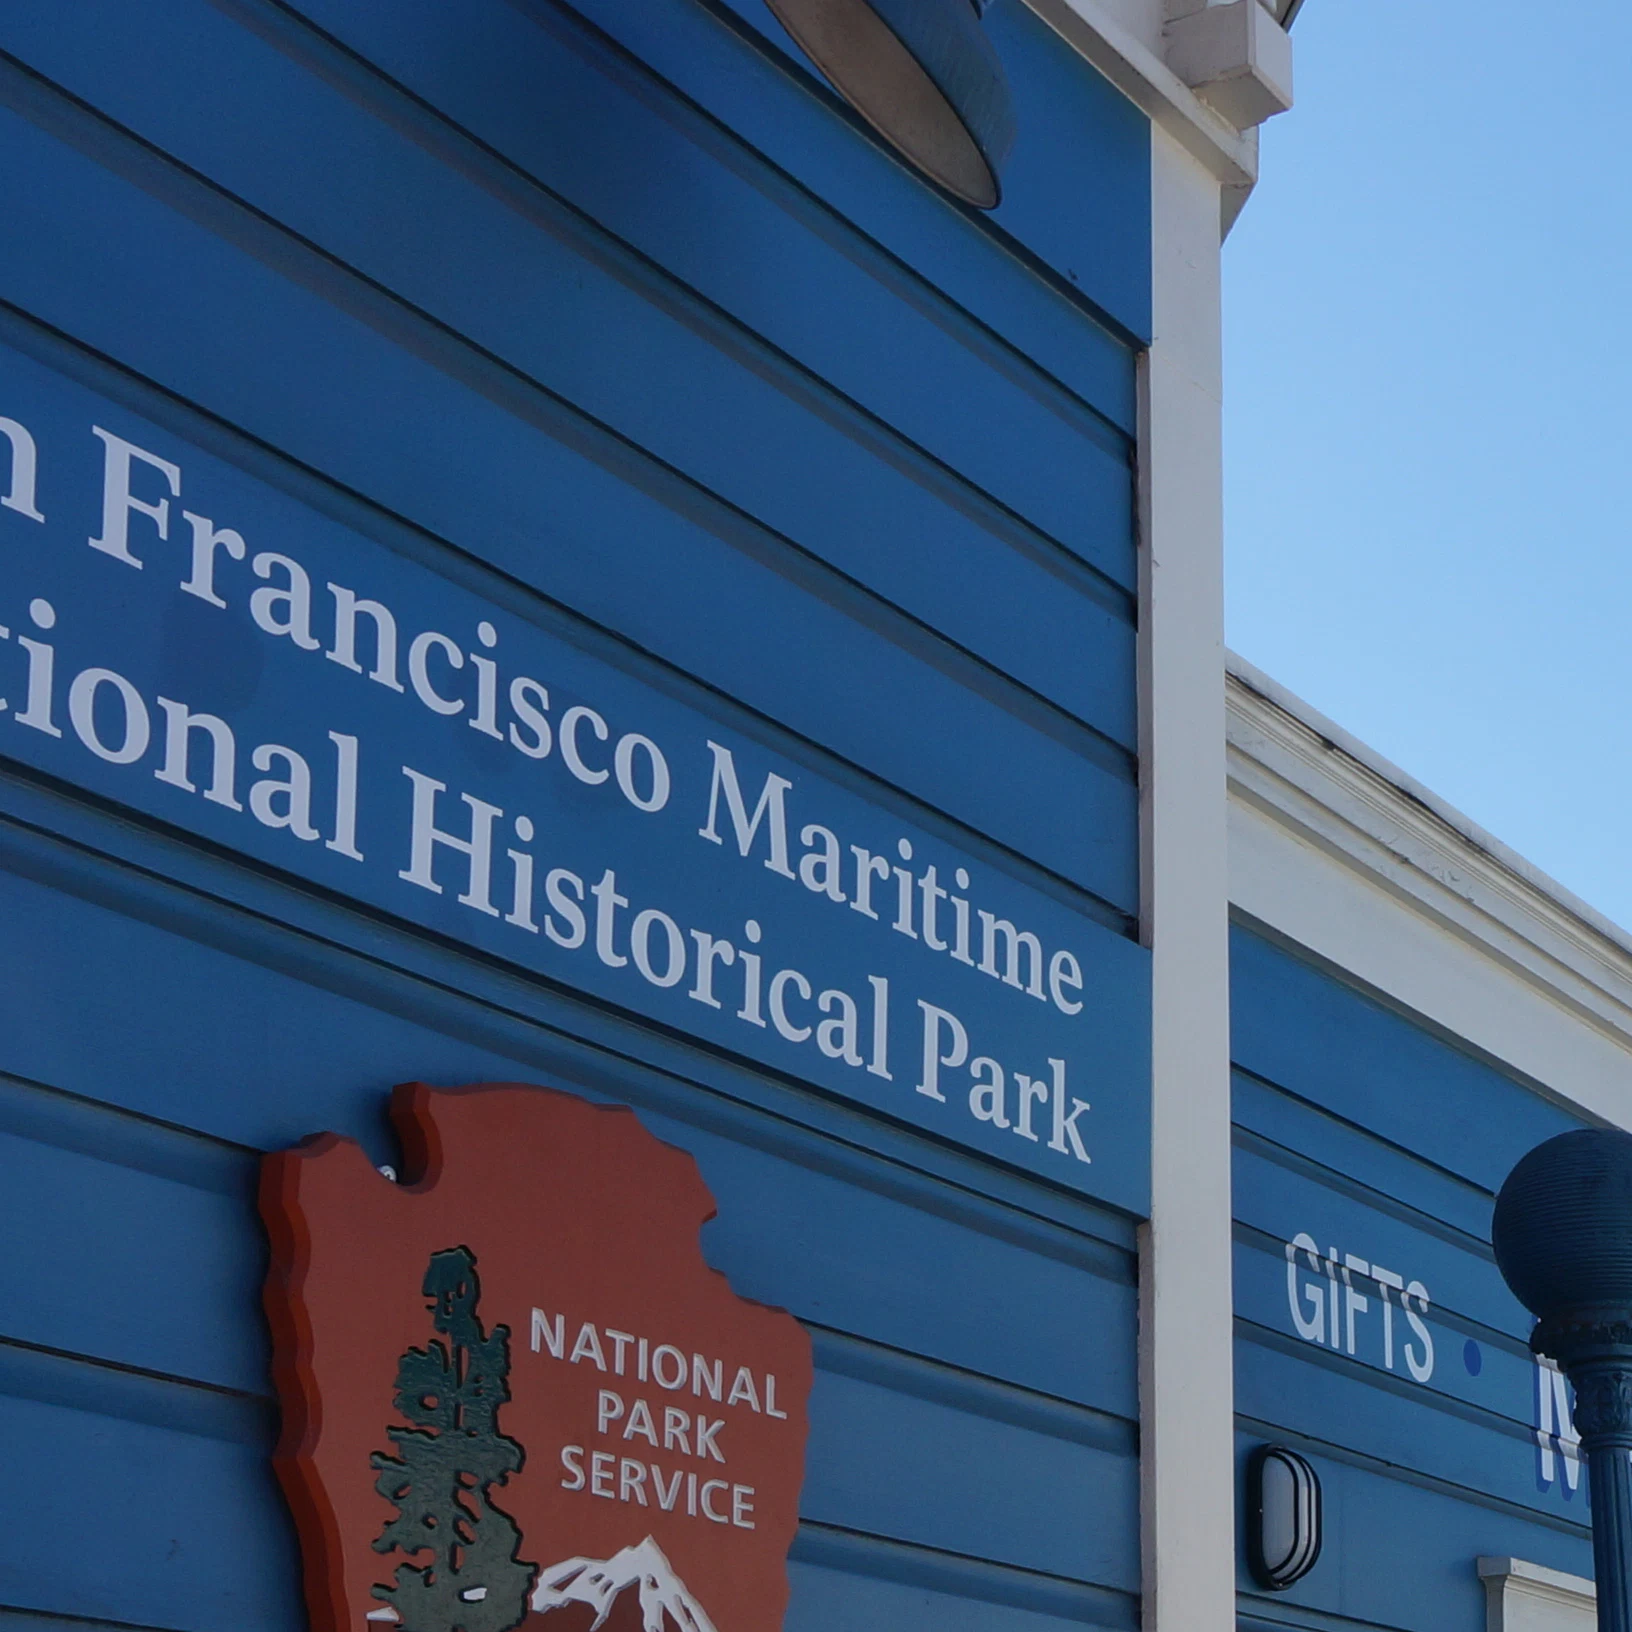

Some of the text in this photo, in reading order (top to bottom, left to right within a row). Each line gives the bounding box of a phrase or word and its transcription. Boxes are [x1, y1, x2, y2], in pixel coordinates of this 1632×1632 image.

[87, 424, 671, 813] Francisco
[698, 739, 1084, 1016] Maritime
[0, 598, 1091, 1164] ional Historical Park
[530, 1306, 788, 1420] NATIONAL
[1284, 1232, 1435, 1383] GIFTS
[560, 1444, 756, 1530] SERVICE
[597, 1389, 727, 1464] PARK
